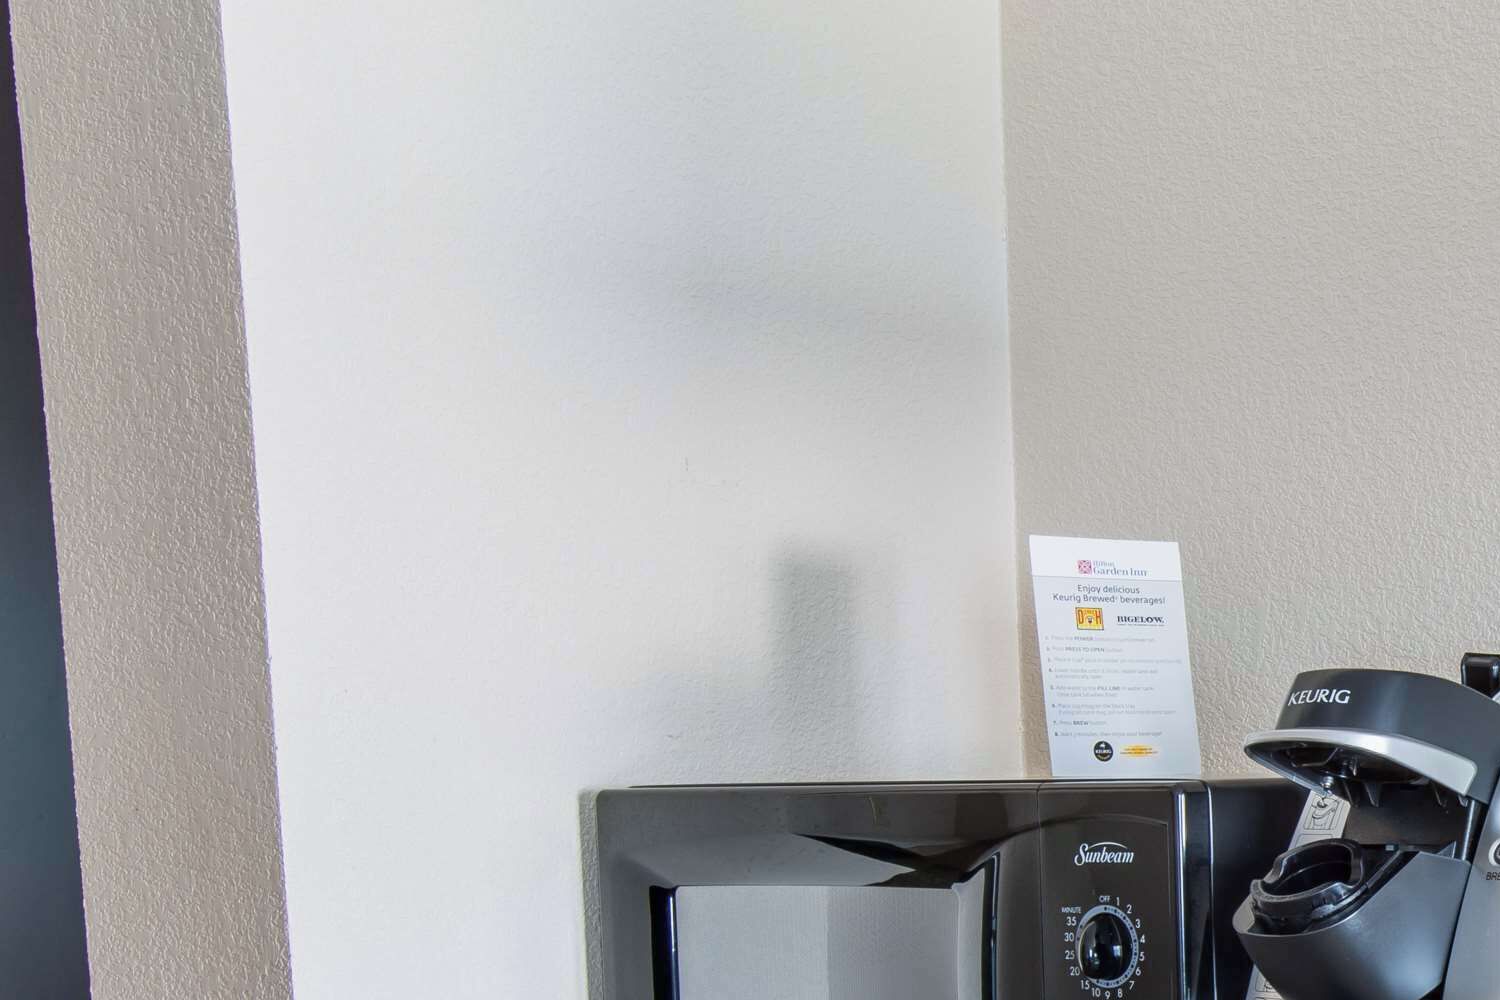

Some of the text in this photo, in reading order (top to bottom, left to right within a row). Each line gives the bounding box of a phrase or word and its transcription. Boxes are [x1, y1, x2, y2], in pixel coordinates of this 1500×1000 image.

[1093, 567, 1147, 576] Garden Inn
[1078, 584, 1140, 594] Enjoy delicious
[1052, 593, 1081, 603] Keurig
[1120, 596, 1166, 606] beverages!
[1288, 689, 1351, 706] KEURIG
[1074, 843, 1134, 866] Sunbeam
[1116, 897, 1120, 906] 1
[1062, 906, 1082, 914] MINUTE
[1126, 904, 1132, 914] 2
[1066, 916, 1076, 926] 35
[1136, 918, 1140, 928] 3
[1064, 932, 1074, 942] 30
[1140, 934, 1146, 943] 4
[1064, 950, 1075, 960] 25
[1140, 952, 1144, 961] 5
[1070, 966, 1080, 976] 20
[1136, 968, 1142, 976] 6
[1080, 980, 1090, 990] 15
[1130, 980, 1135, 990] 7
[1092, 988, 1101, 998] 10
[1105, 990, 1110, 1000] 9
[1118, 989, 1122, 998] 8
